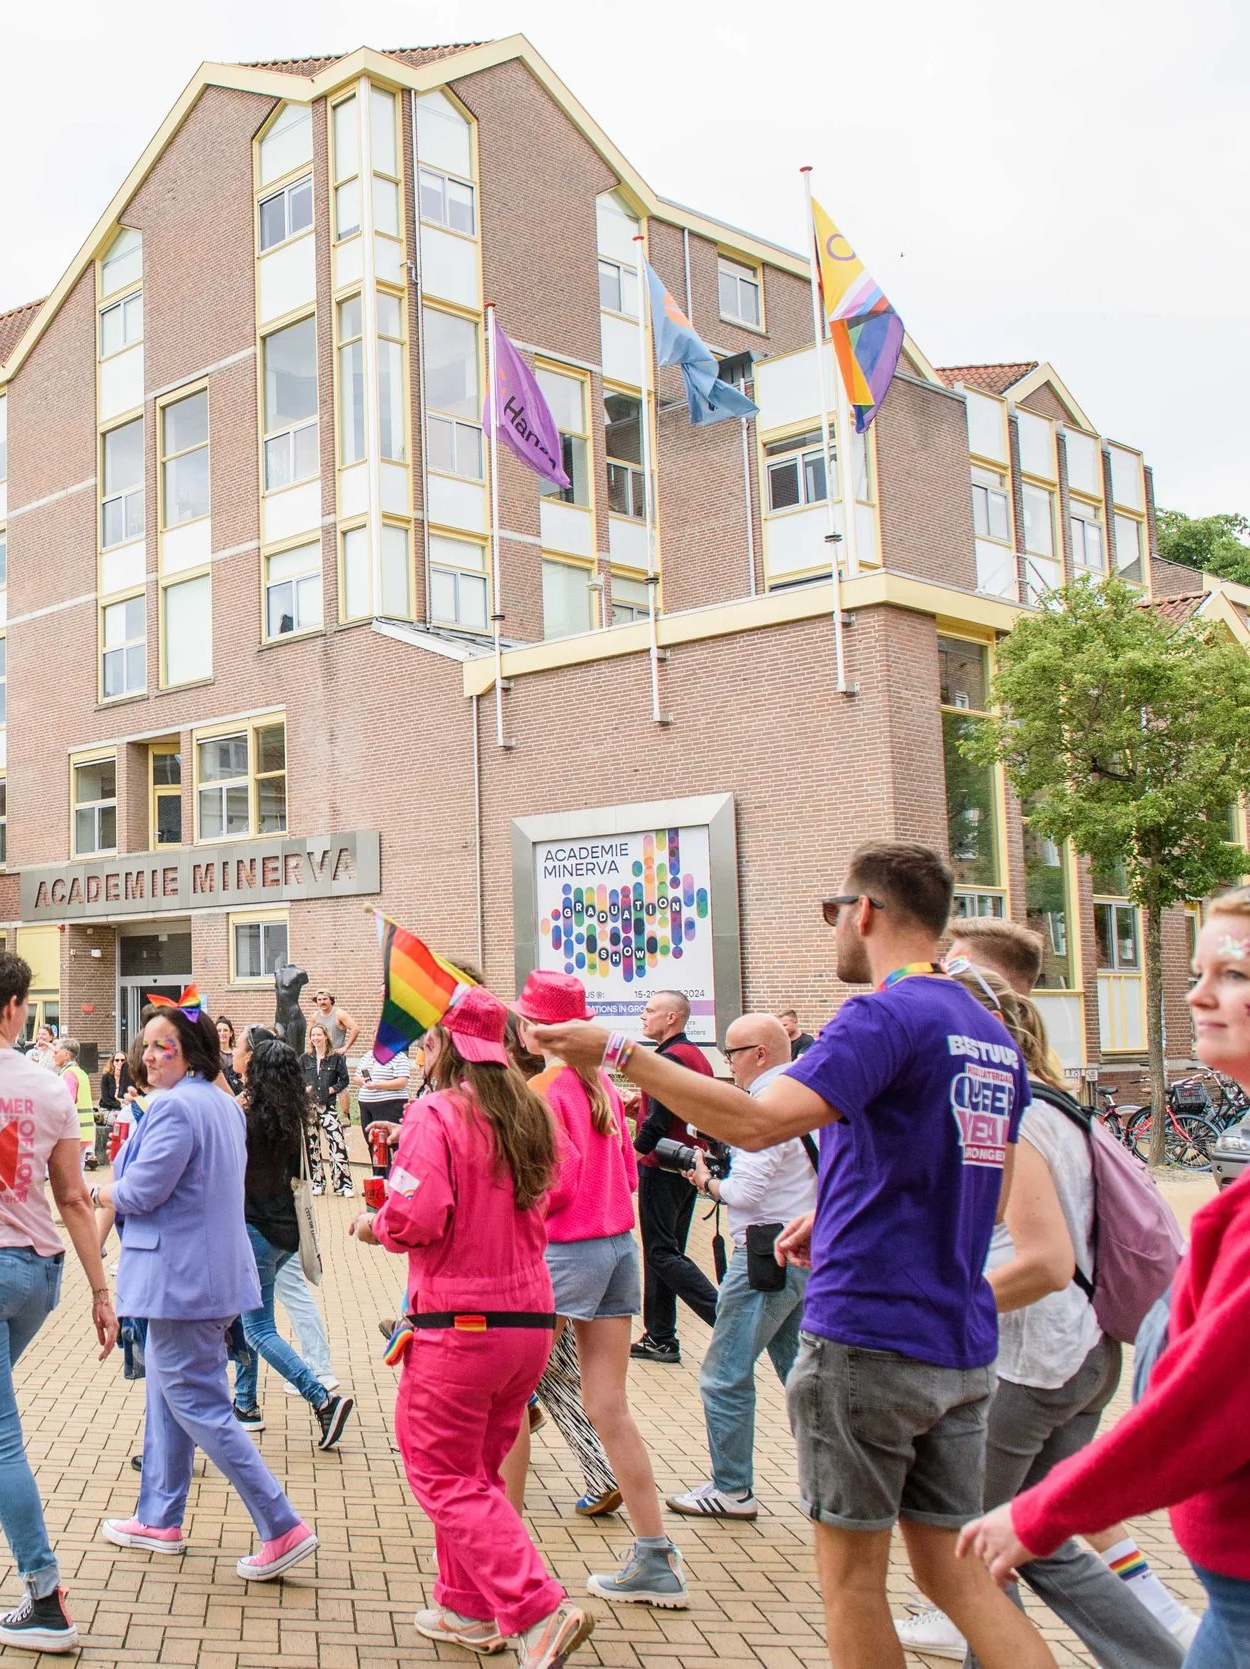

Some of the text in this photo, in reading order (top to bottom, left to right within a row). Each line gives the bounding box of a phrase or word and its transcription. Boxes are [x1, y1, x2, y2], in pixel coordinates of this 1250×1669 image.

[543, 843, 630, 864] ACADEMIE
[34, 848, 357, 908] ACADEMIE MINERVA
[543, 860, 620, 880] MINERVA
[563, 899, 681, 922] GRADUATION
[600, 947, 645, 962] SHOW
[19, 1119, 35, 1148] OF
